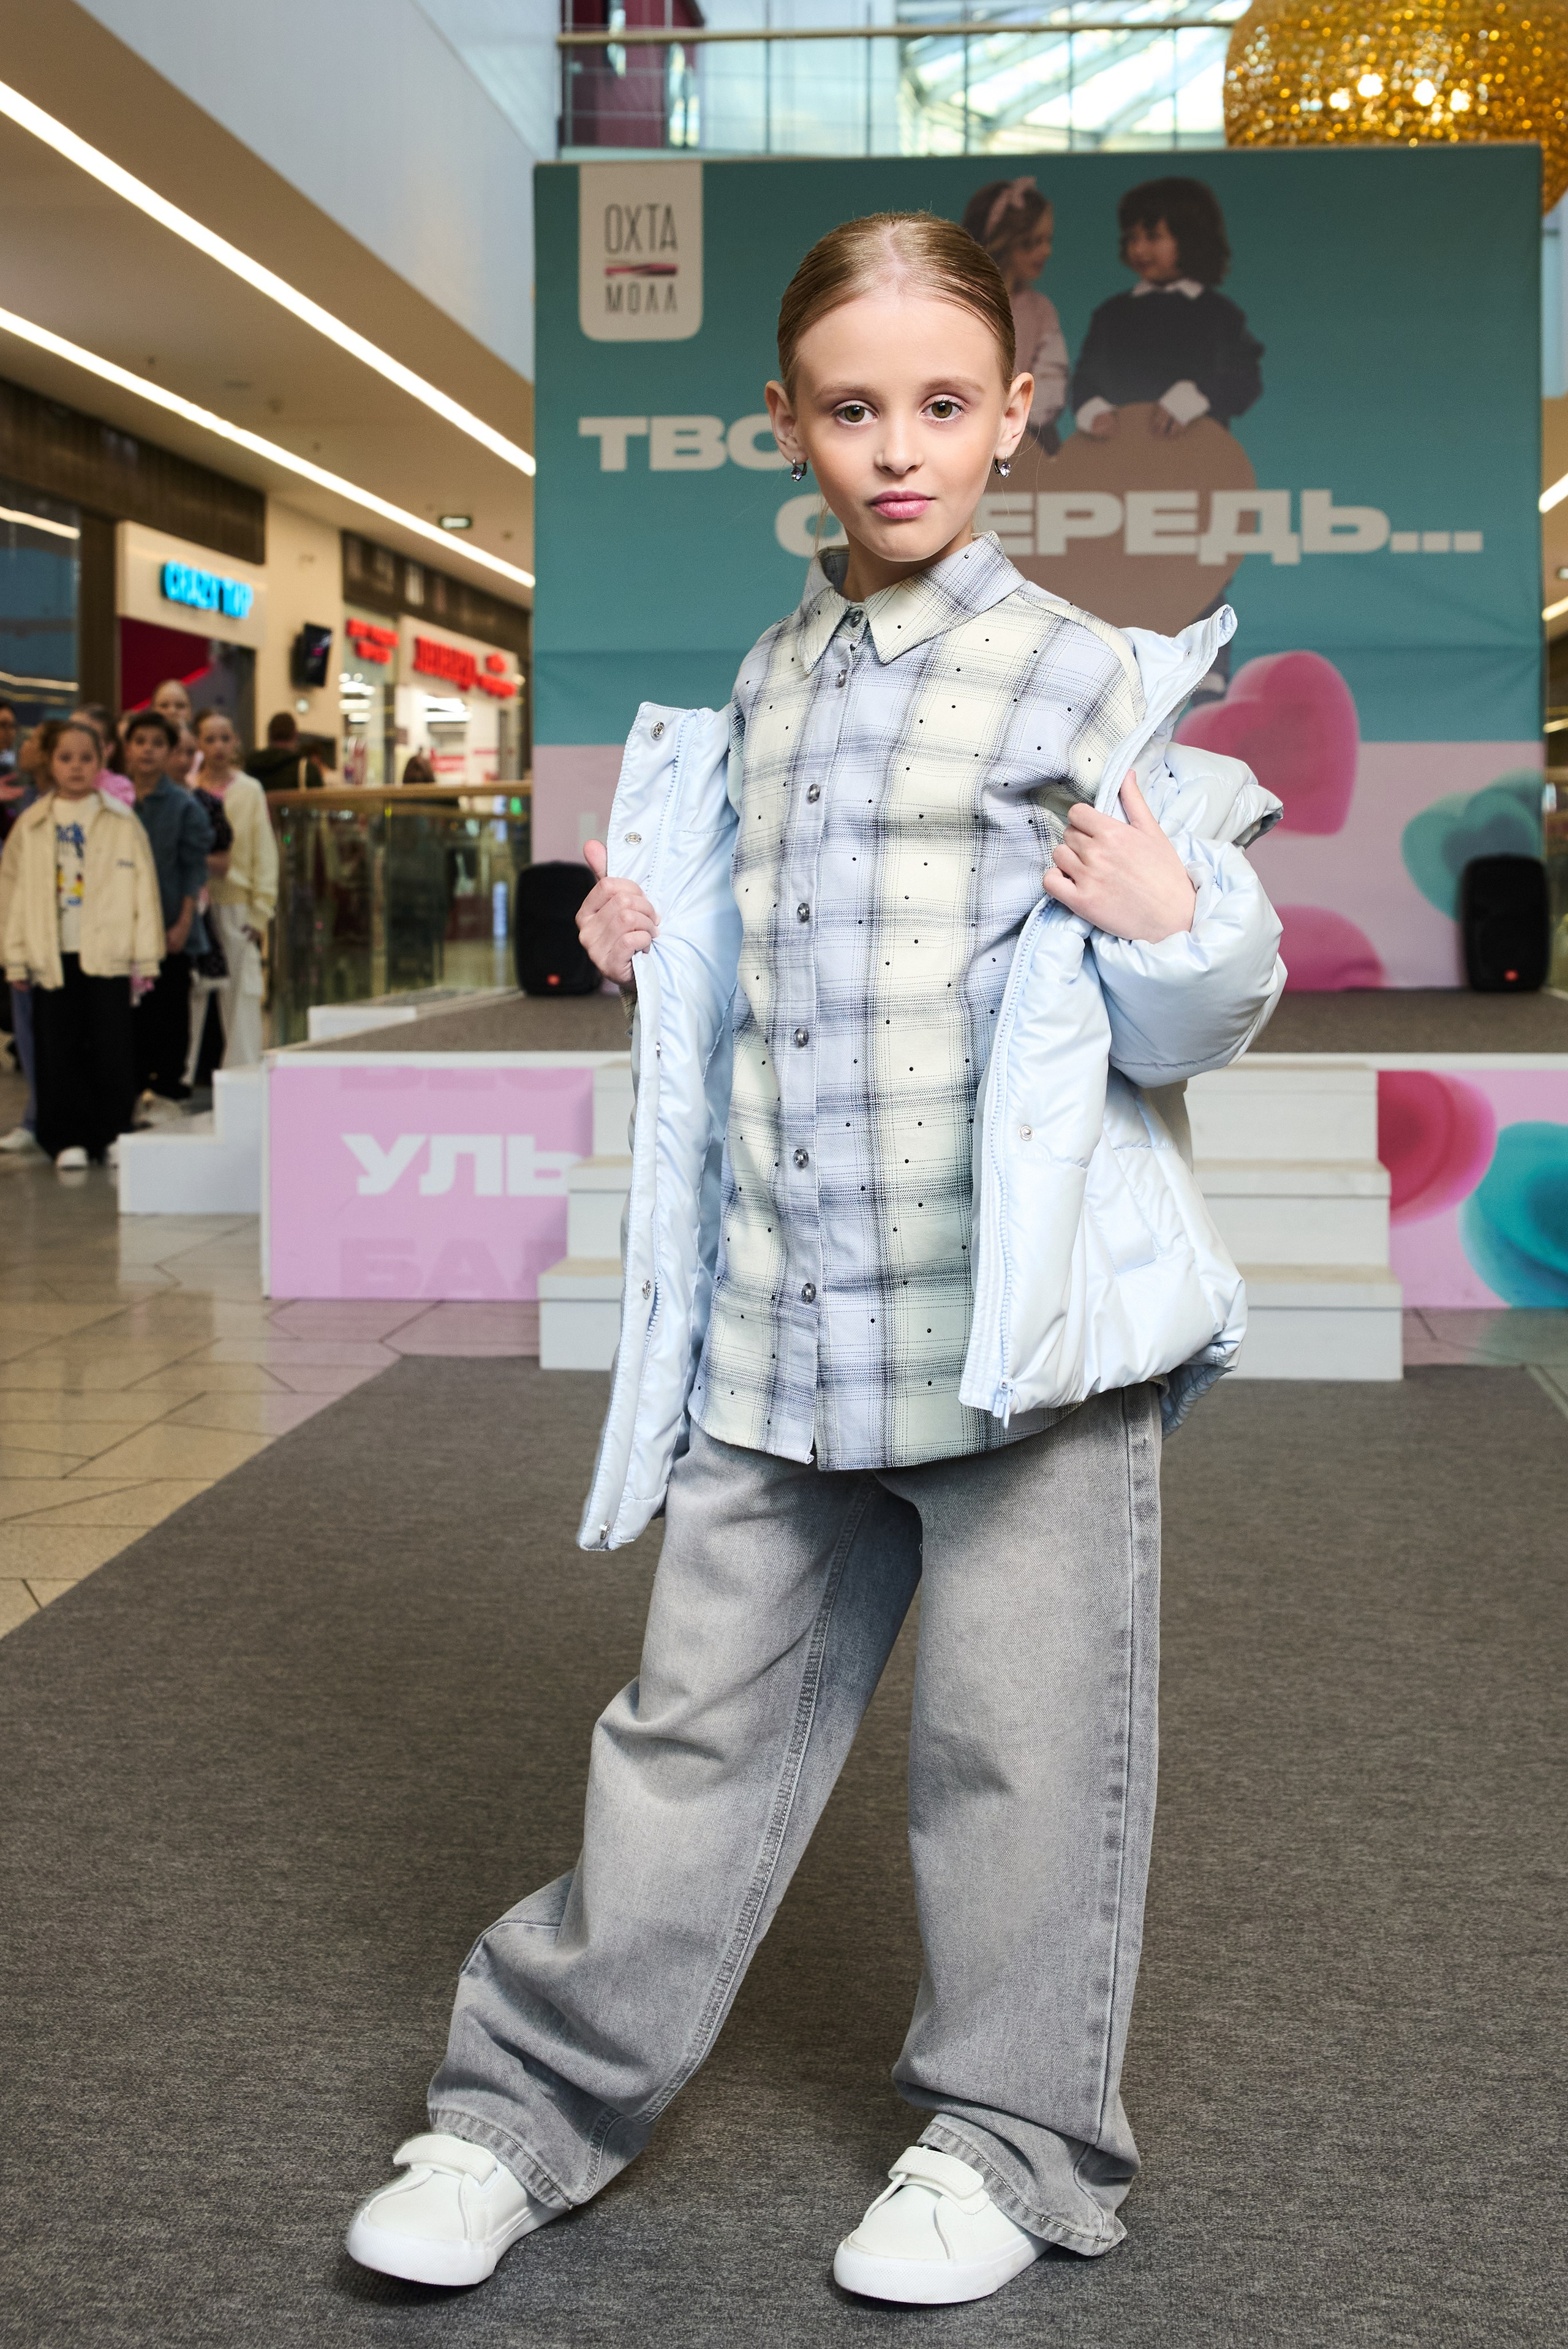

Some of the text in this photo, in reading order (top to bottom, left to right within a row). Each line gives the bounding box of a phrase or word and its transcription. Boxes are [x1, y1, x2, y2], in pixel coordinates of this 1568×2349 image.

[604, 203, 678, 254] ОХТА
[605, 282, 678, 315] МОЛЛ
[578, 413, 793, 471] ТВО
[775, 489, 1483, 565] ОЕРЕДЬ...
